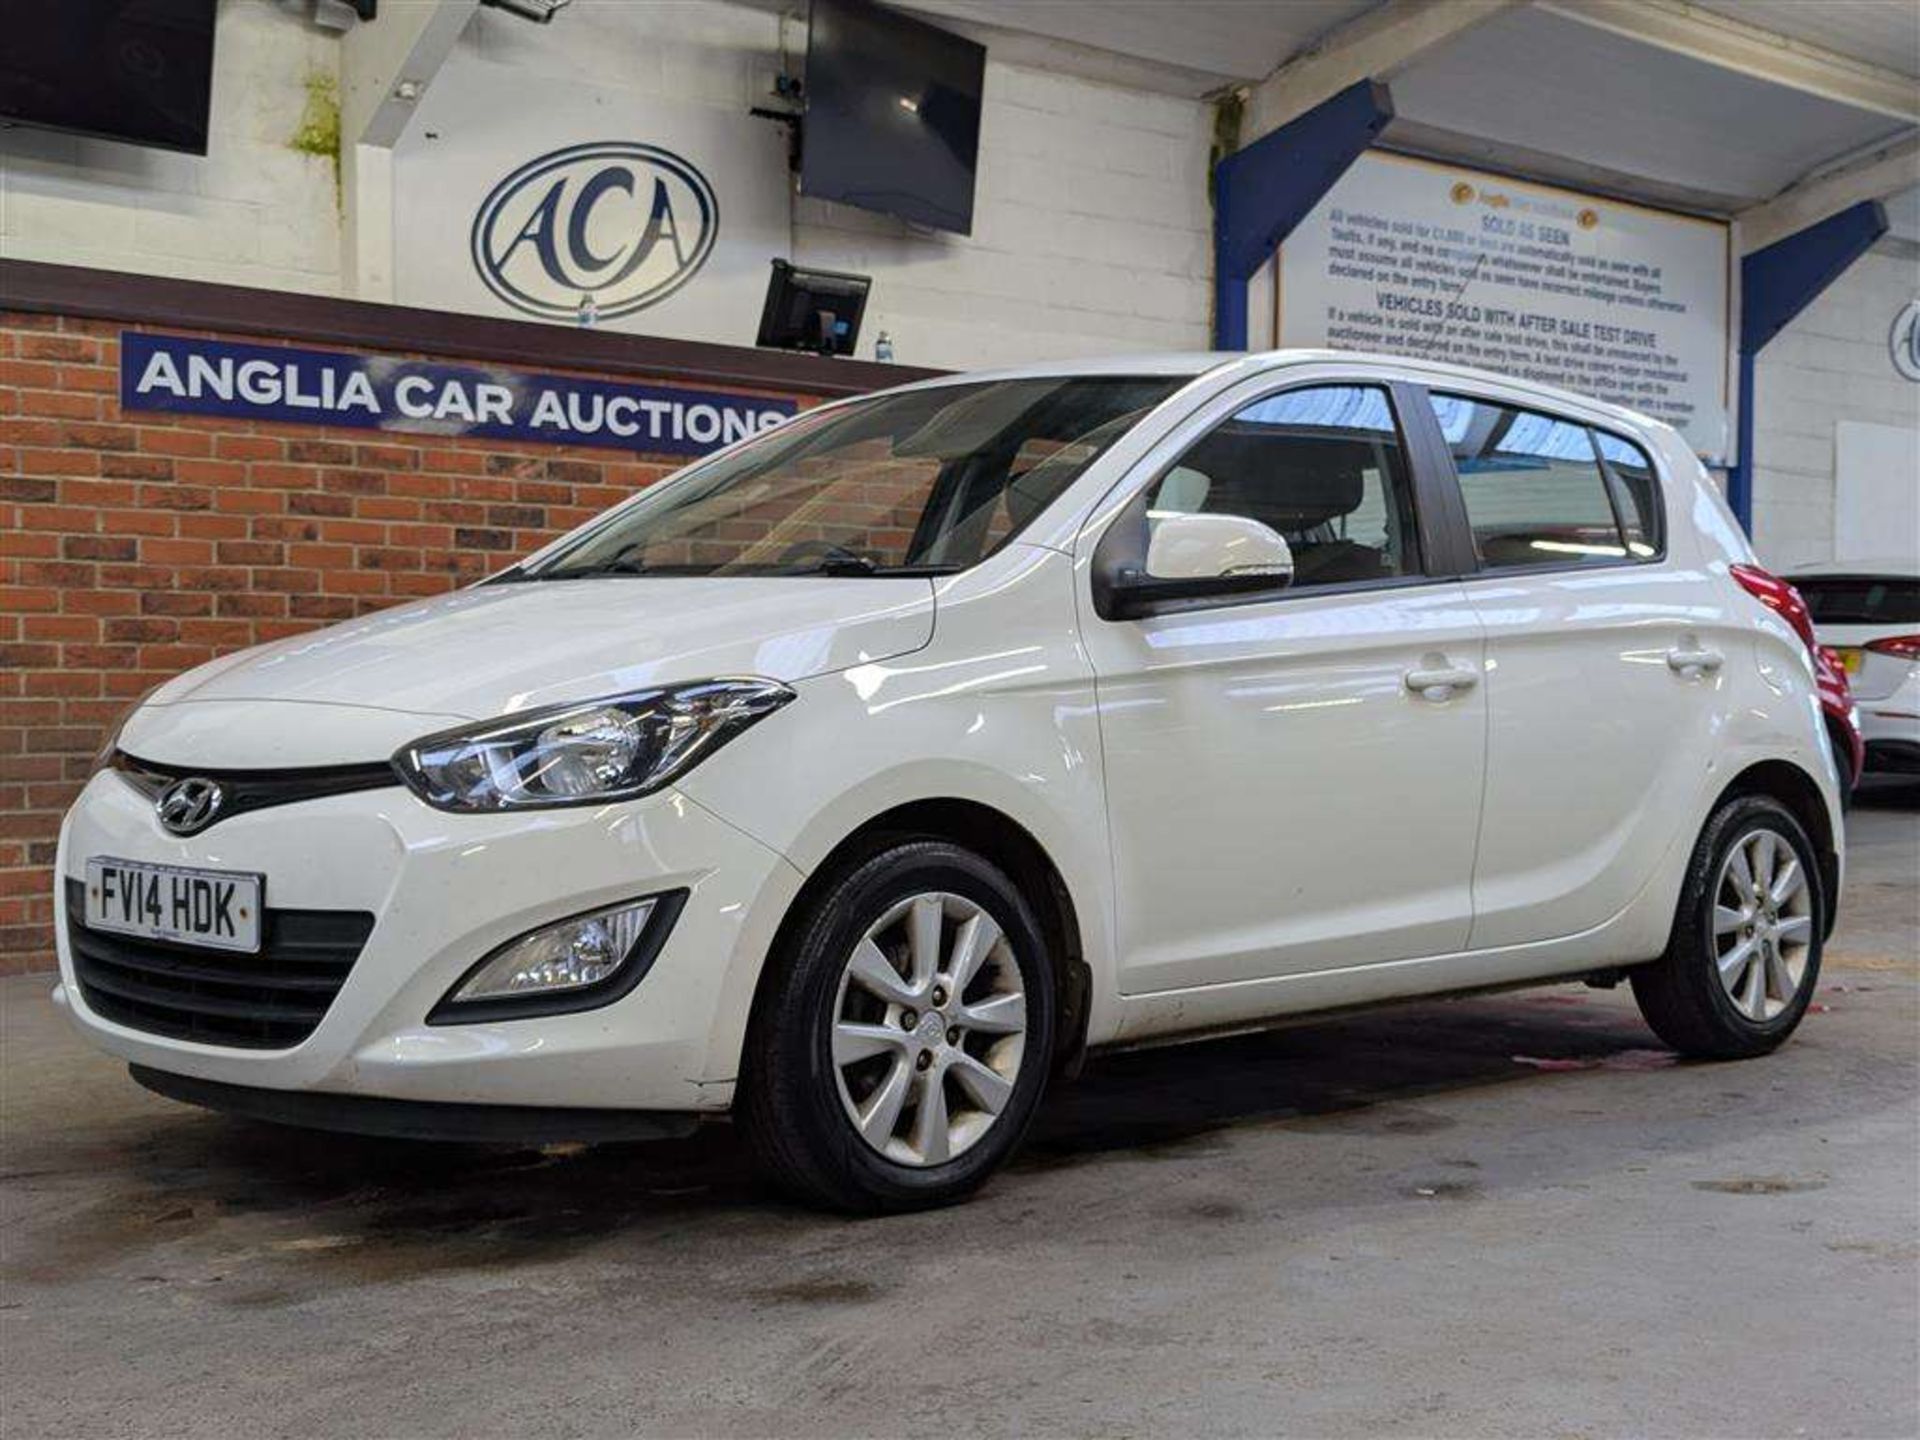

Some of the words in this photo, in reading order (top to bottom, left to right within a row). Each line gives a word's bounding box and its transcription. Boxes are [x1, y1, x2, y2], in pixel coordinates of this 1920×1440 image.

[496, 166, 686, 291] ACA
[1346, 214, 1388, 231] vehicles
[1392, 221, 1413, 235] sold
[1517, 244, 1575, 265] automatically
[1577, 255, 1595, 268] sold
[1611, 261, 1630, 273] seen
[1632, 264, 1649, 276] with
[1482, 215, 1516, 235] SOLD
[1519, 222, 1534, 238] AS
[1539, 226, 1570, 245] SEEN
[1328, 263, 1374, 281] declared
[1377, 271, 1389, 282] on
[1392, 272, 1408, 284] the
[1411, 276, 1437, 292] entry
[1328, 246, 1355, 259] must
[1358, 251, 1397, 265] assume
[1401, 257, 1413, 268] all
[1416, 260, 1455, 275] vehicles
[1494, 273, 1517, 285] seen
[1518, 275, 1539, 288] have
[1542, 278, 1581, 296] incorrect
[1584, 288, 1616, 304] mileage
[1618, 293, 1645, 307] unless
[1647, 298, 1686, 313] otherwise
[1401, 240, 1419, 253] and
[1422, 243, 1434, 255] no
[1545, 264, 1566, 277] shall
[1347, 311, 1383, 326] vehicle
[1398, 319, 1420, 331] sold
[1446, 326, 1458, 335] an
[1460, 326, 1481, 338] after
[1484, 329, 1502, 342] sale
[1505, 332, 1522, 345] test
[1552, 339, 1568, 351] this
[1571, 342, 1591, 354] shall
[1665, 354, 1678, 365] the
[1376, 292, 1442, 316] VEHICLES
[1446, 303, 1480, 322] SOLD
[1484, 308, 1514, 325] WITH
[1519, 314, 1557, 333] AFTER
[1560, 319, 1590, 338] SALE
[1594, 324, 1621, 343] TEST
[1623, 329, 1656, 348] DRIVE
[1327, 327, 1382, 343] auctioneer
[1385, 333, 1404, 345] and
[1407, 335, 1450, 351] declared
[1466, 342, 1481, 354] the
[1483, 346, 1507, 362] entry
[1544, 354, 1561, 366] test
[1564, 357, 1585, 368] drive
[1587, 360, 1615, 373] covers
[136, 352, 381, 413] ANGLIA
[395, 376, 513, 424] CAR
[1577, 373, 1591, 386] the
[1593, 376, 1618, 389] office
[1620, 379, 1635, 391] and
[1637, 381, 1653, 393] with
[1655, 384, 1668, 395] the
[1663, 400, 1695, 412] member
[102, 868, 162, 926] FV14
[173, 877, 235, 937] HDK
